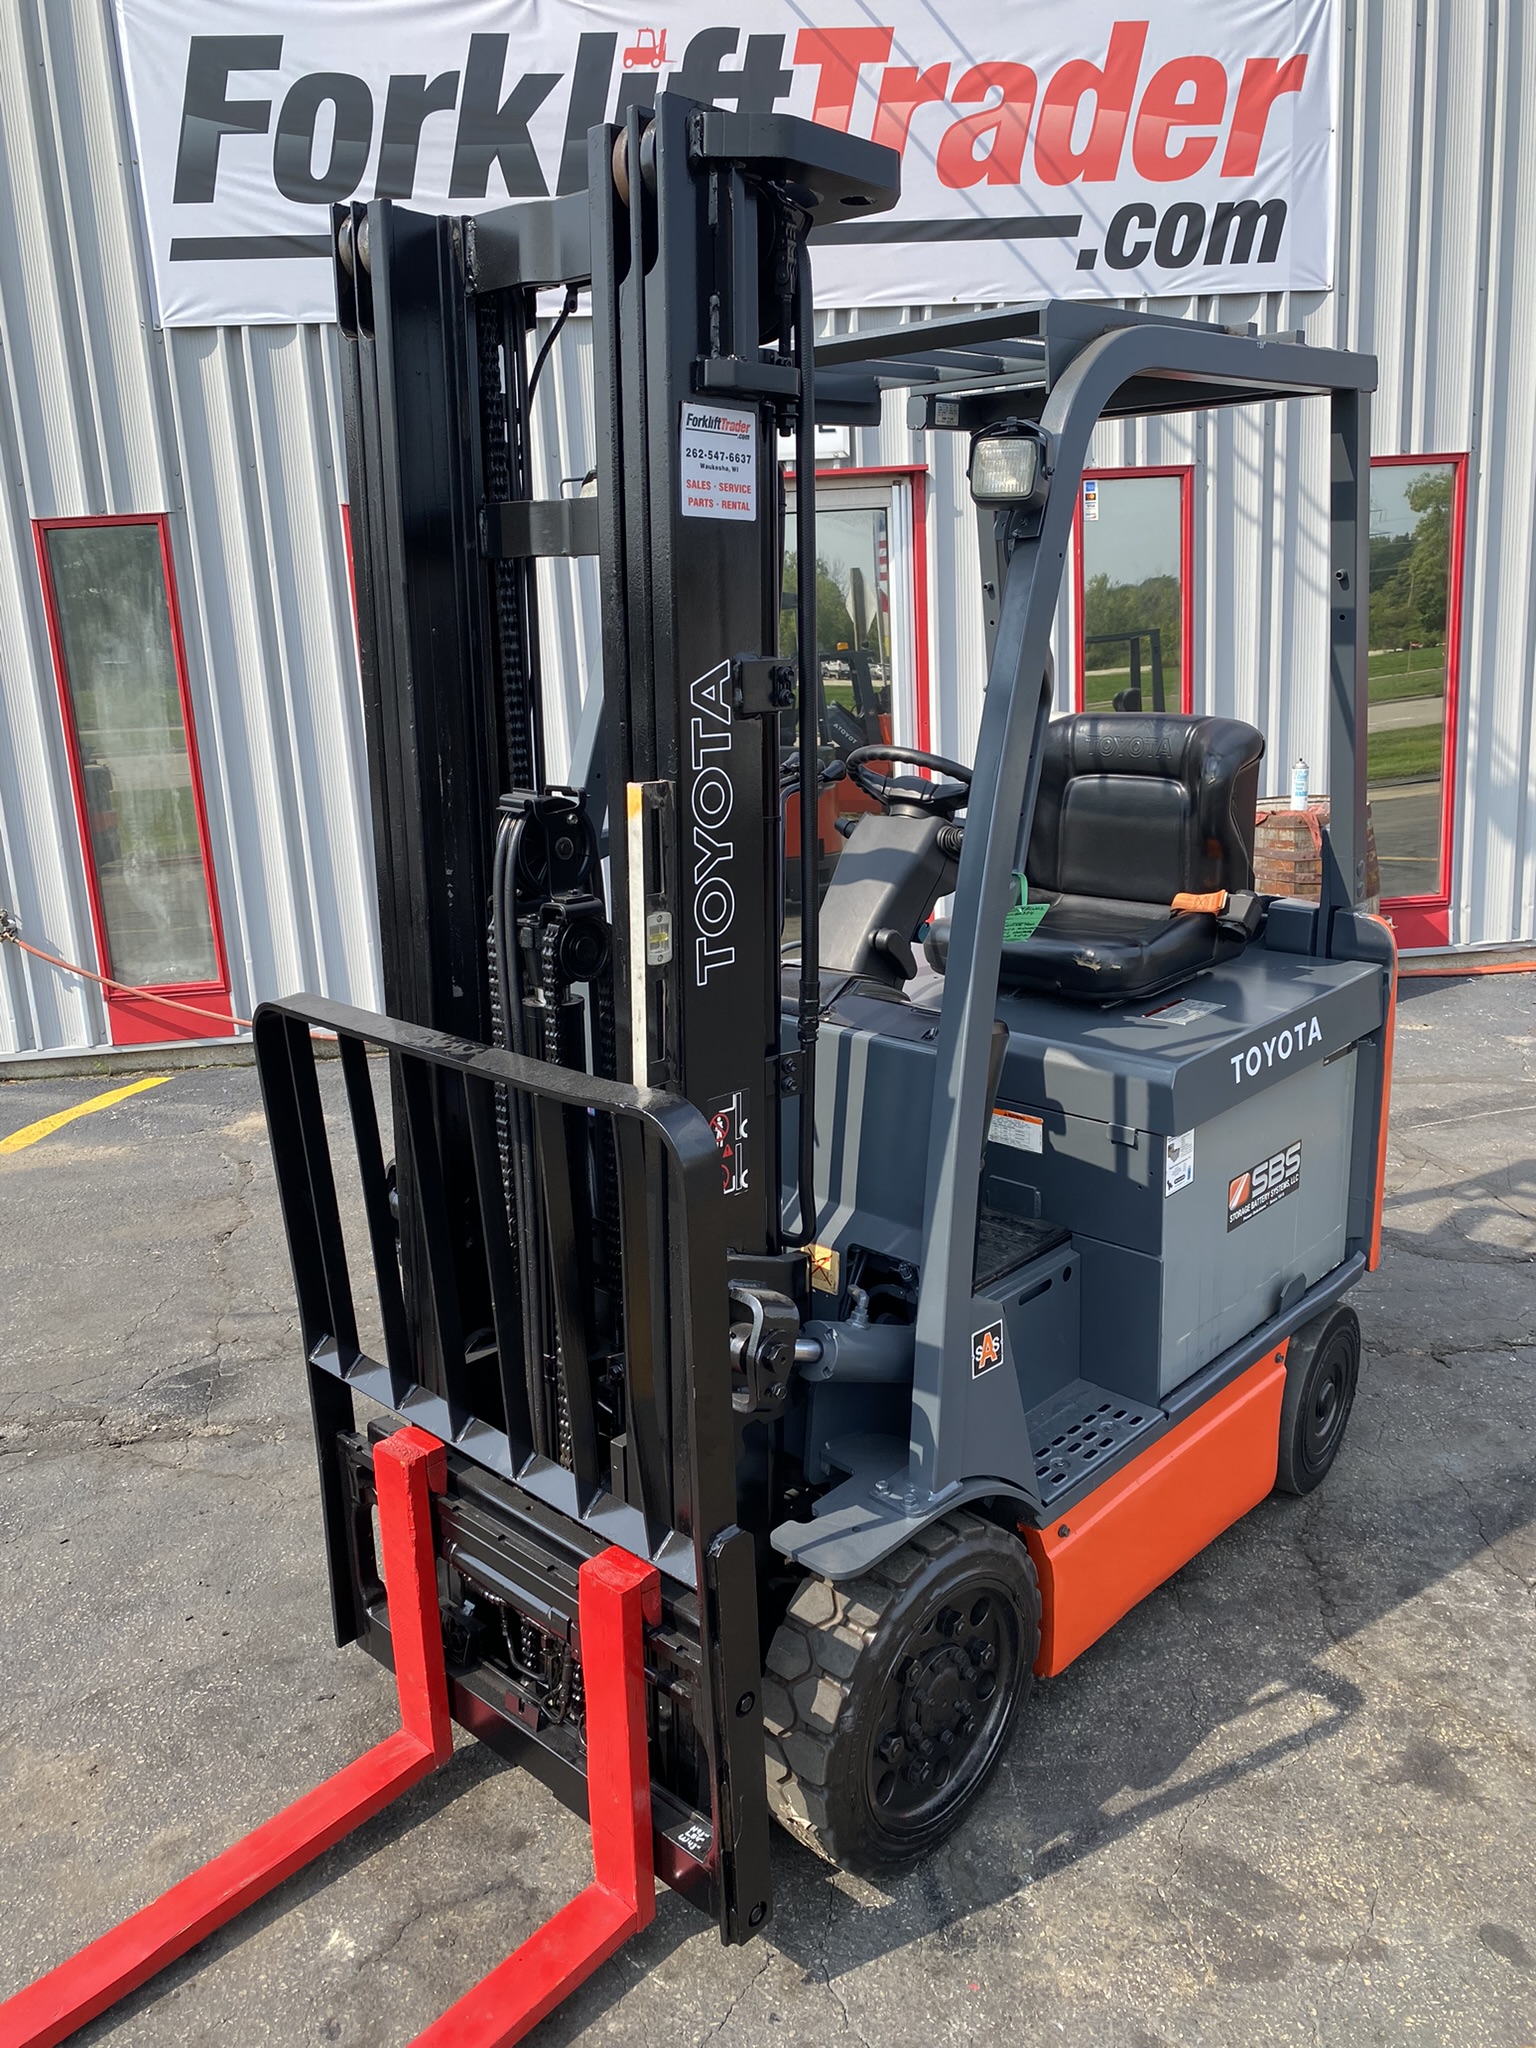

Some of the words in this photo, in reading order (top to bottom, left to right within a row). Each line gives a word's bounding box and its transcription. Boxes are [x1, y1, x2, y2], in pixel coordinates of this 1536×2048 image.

[1076, 198, 1288, 271] .com
[686, 413, 750, 433] ForkliftTrader
[700, 463, 730, 472] Waukesha,
[686, 479, 711, 491] SALES
[719, 482, 751, 494] SERVICE
[688, 497, 713, 508] PARTS
[721, 500, 750, 511] RENTAL
[1085, 734, 1174, 760] TOYOTA
[690, 658, 736, 987] TOYOTA
[1230, 1015, 1323, 1085] TOYOTA
[1251, 1142, 1301, 1199] SBS
[1229, 1203, 1251, 1223] STORAGE
[1250, 1192, 1270, 1210] BATTERY
[1290, 1174, 1299, 1185] LLC
